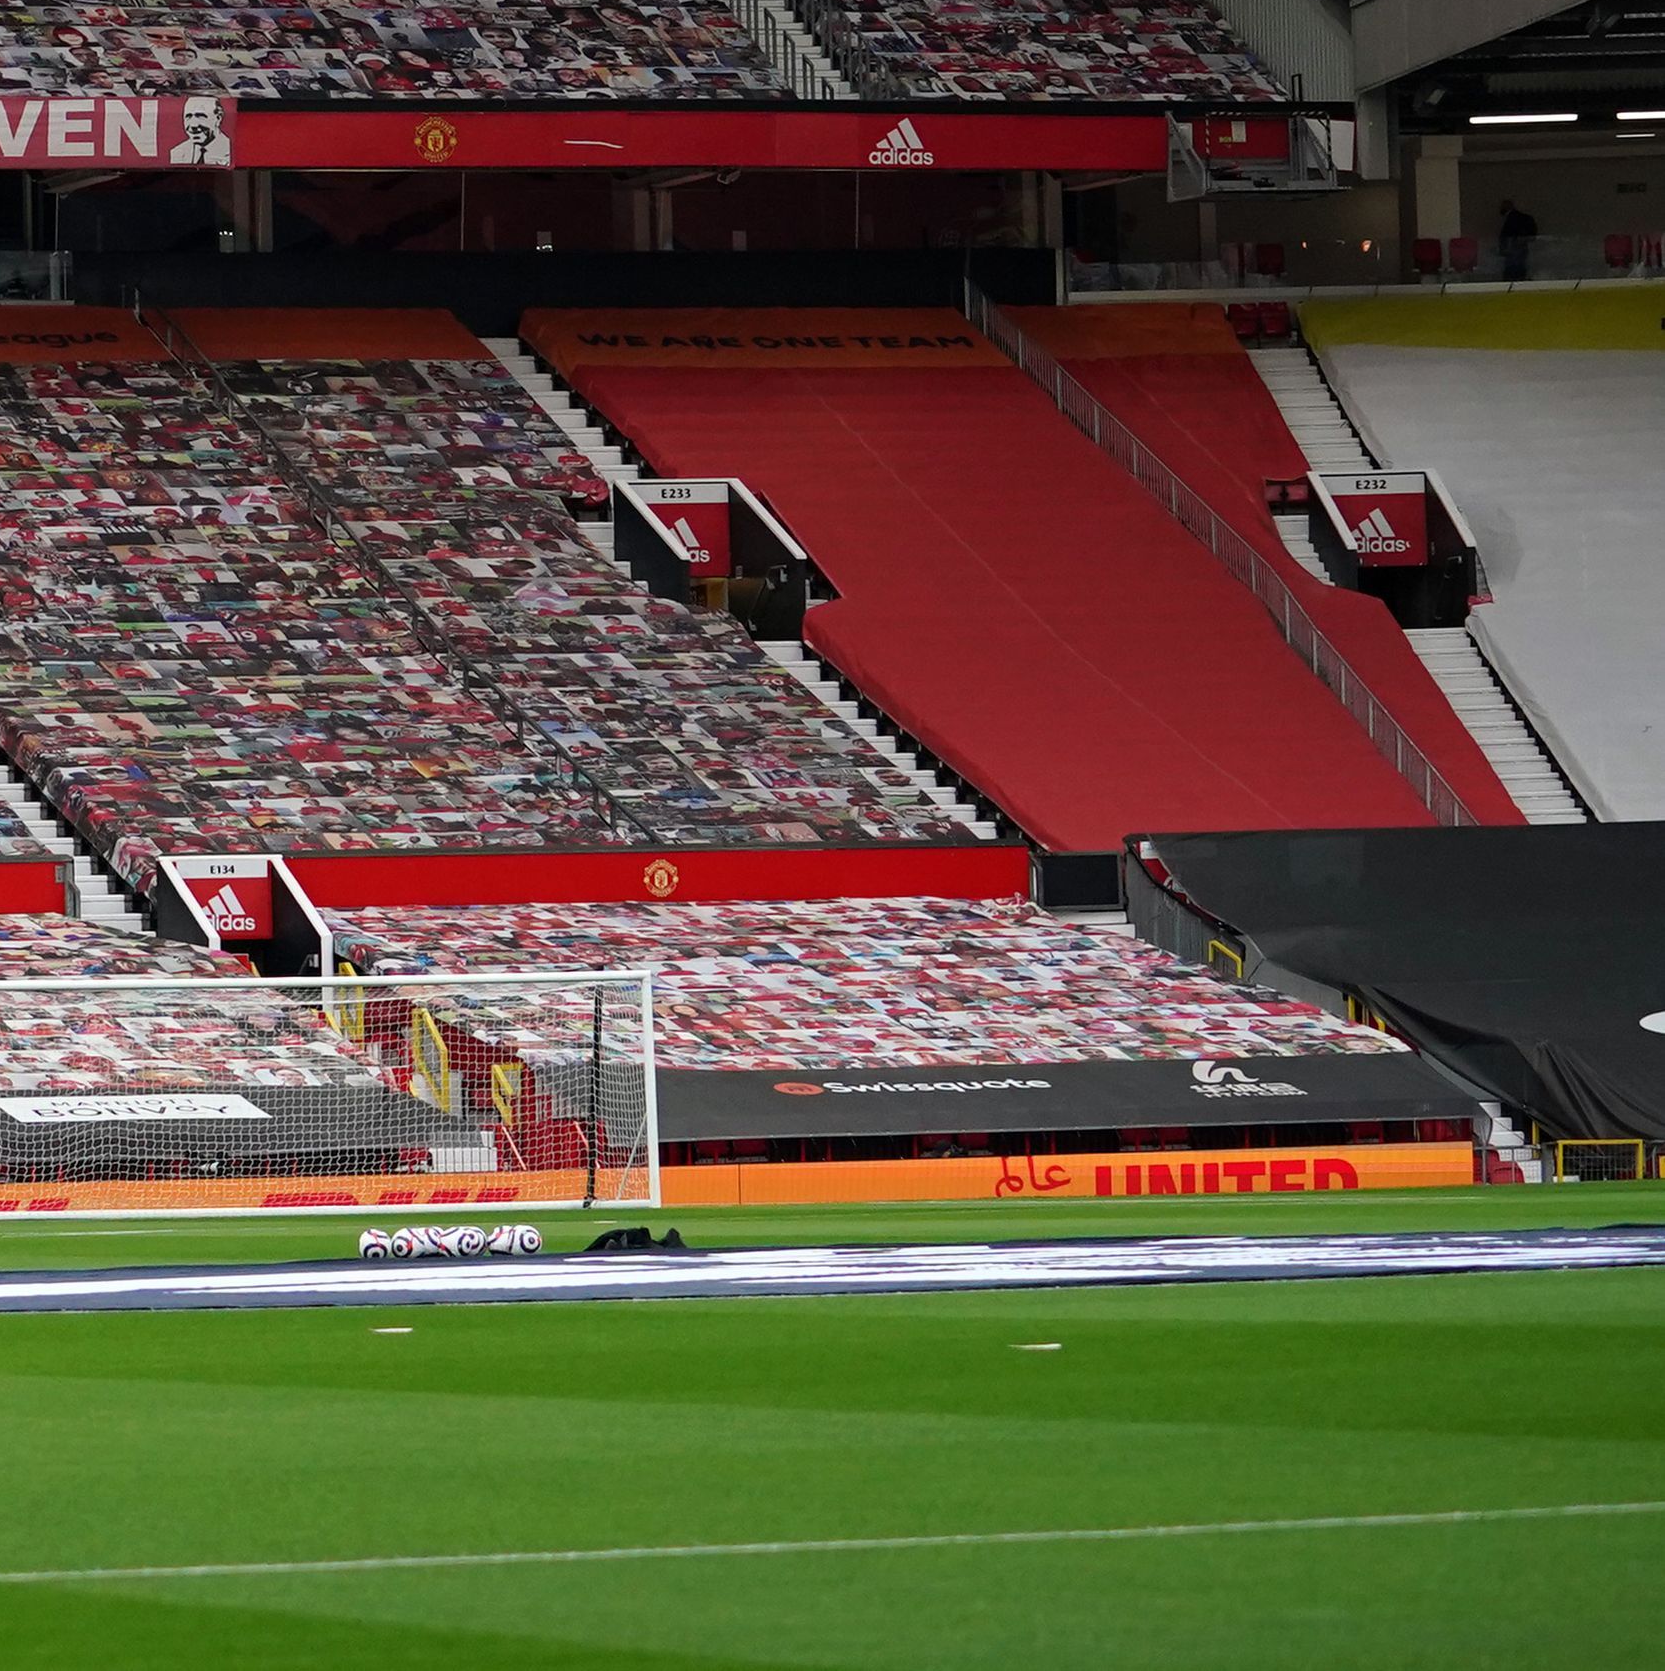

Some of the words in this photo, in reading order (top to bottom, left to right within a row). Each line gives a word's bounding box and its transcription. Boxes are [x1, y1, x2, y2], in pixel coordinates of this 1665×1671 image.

[869, 147, 933, 165] adidas
[577, 333, 648, 348] WE
[661, 335, 744, 349] ARE
[752, 336, 844, 349] ONE
[849, 336, 975, 349] TEAM
[1356, 480, 1387, 490] E232
[661, 489, 691, 498] E233
[1357, 537, 1406, 553] didas
[823, 1078, 1053, 1094] Swissquote
[32, 1105, 231, 1117] BONVOY
